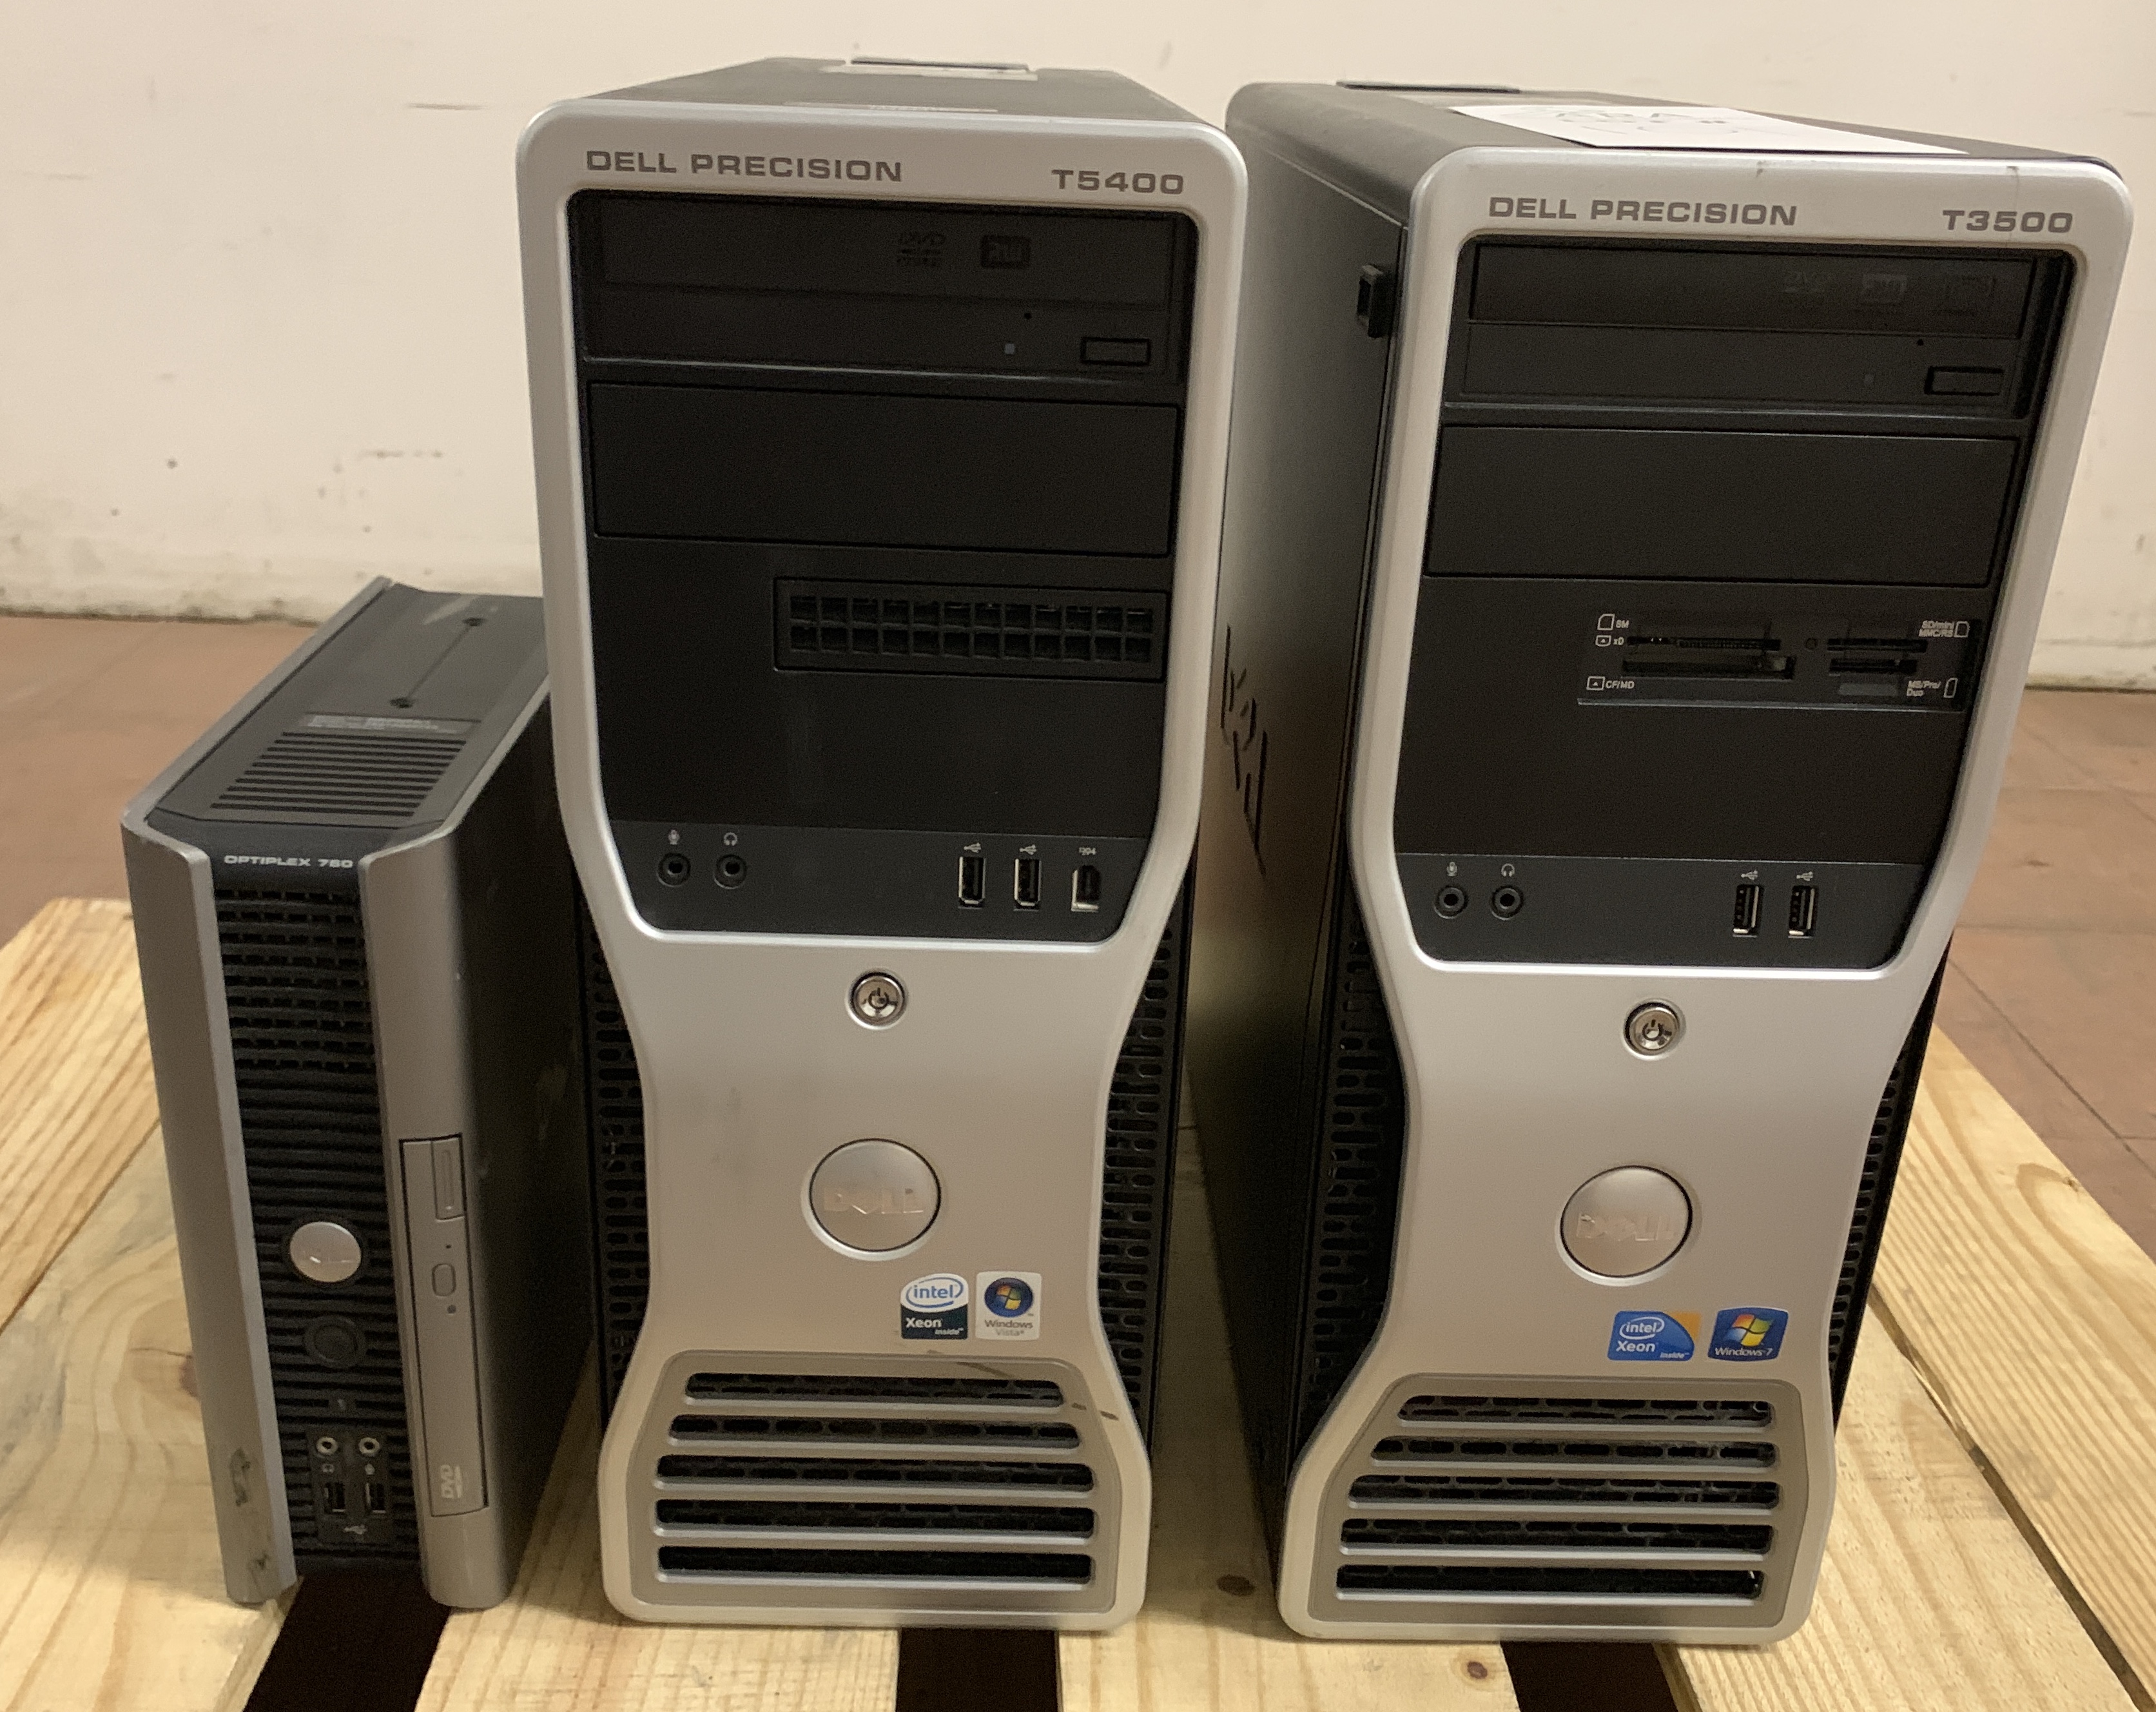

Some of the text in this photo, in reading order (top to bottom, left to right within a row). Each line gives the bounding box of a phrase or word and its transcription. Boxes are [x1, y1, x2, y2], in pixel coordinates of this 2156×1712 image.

[586, 150, 902, 182] DELL PRECISION
[1051, 169, 1185, 195] T5400
[1489, 197, 1798, 227] DELL PRECISION
[1942, 209, 2075, 235] T3500
[1616, 619, 1629, 628] SM
[224, 855, 311, 867] OPTIPLEX
[913, 1284, 954, 1299] intel
[905, 1317, 942, 1328] Xeon
[984, 1319, 1034, 1329] Windows
[1625, 1321, 1658, 1333] intel
[1615, 1340, 1656, 1352] Xeon
[1714, 1345, 1773, 1356] Windows 7
[440, 1464, 455, 1499] DVD
